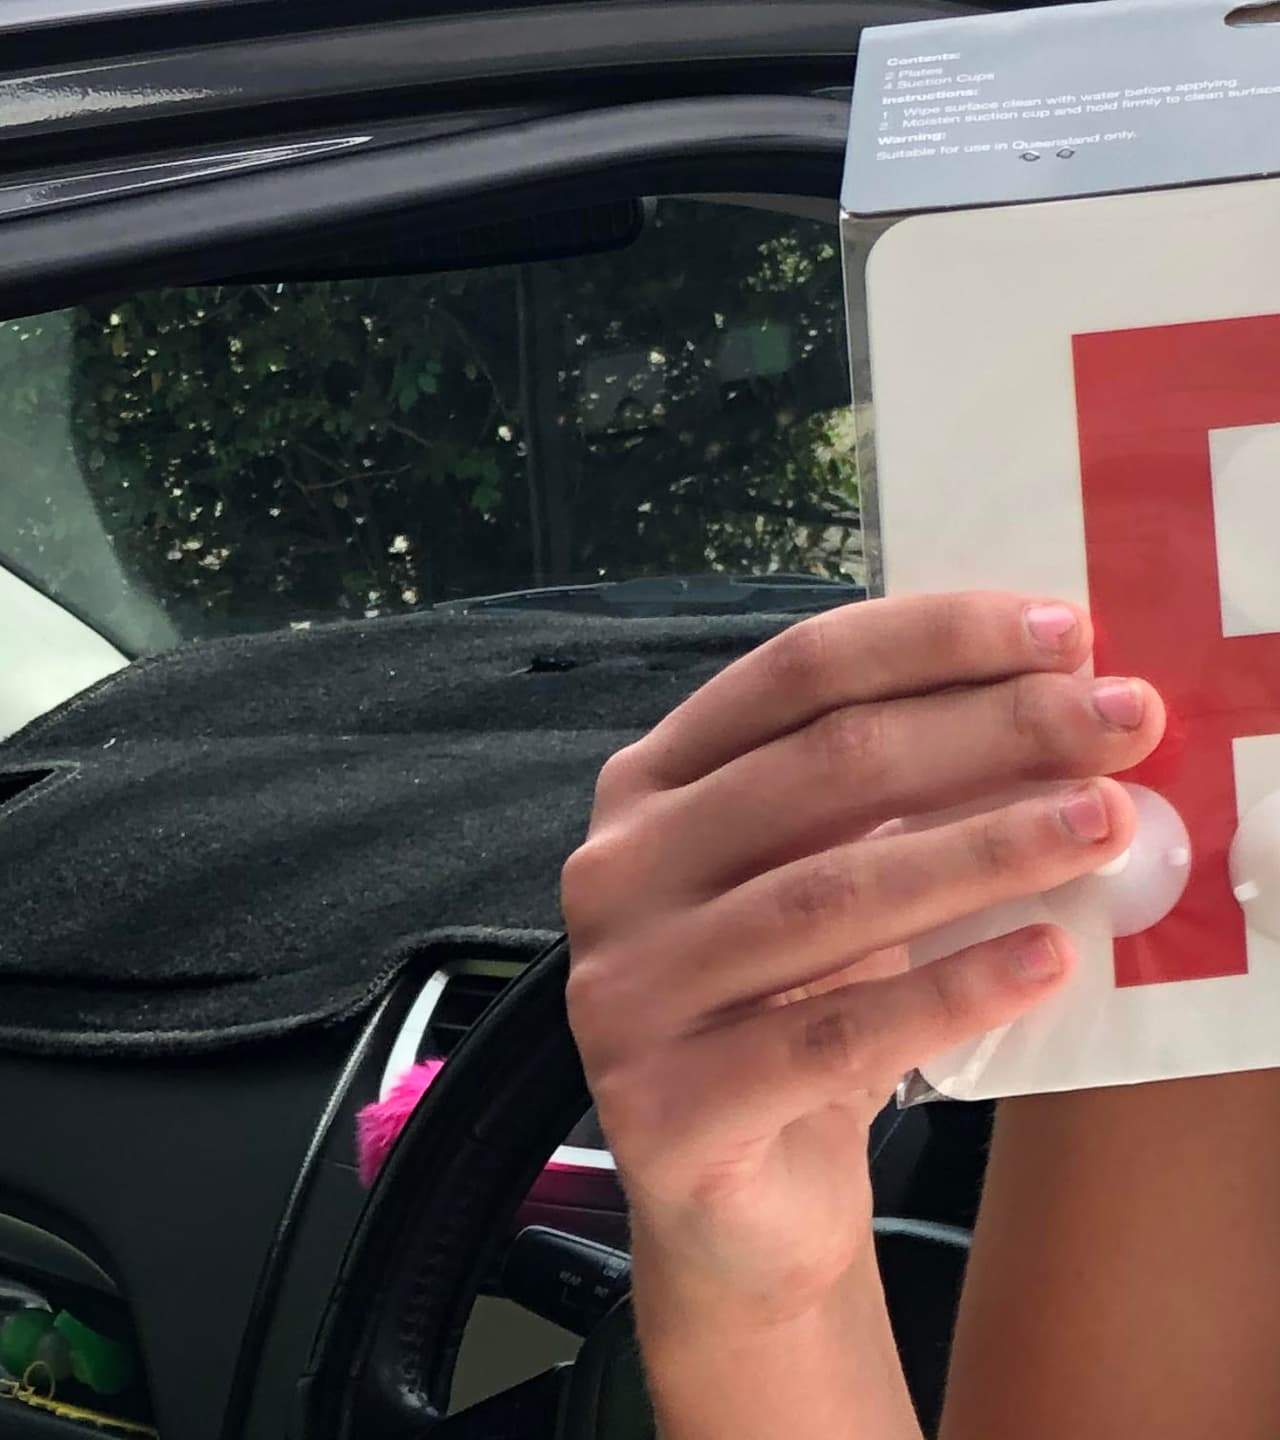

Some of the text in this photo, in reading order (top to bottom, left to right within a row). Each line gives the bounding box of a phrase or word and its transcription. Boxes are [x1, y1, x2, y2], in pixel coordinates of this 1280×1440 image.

[886, 52, 961, 67] Contents:
[897, 77, 952, 91] Suction
[956, 72, 995, 85] Cups
[898, 67, 943, 80] Plates
[882, 88, 979, 106] Instructions:
[903, 106, 941, 118] Wipe
[944, 100, 999, 113] surface
[1002, 97, 1042, 109] clean
[1046, 94, 1076, 106] with
[1081, 90, 1121, 103] water
[1125, 84, 1172, 97] before
[902, 114, 961, 129] Moisten
[964, 108, 1018, 122] suction
[1022, 109, 1050, 120] cup
[1054, 105, 1082, 116] and
[1086, 101, 1118, 113] hold
[1122, 97, 1162, 109] firmly
[1184, 91, 1224, 102] clean
[876, 146, 937, 161] Suitable
[940, 144, 960, 155] for
[964, 143, 991, 153] use
[1012, 133, 1100, 150] Queensland
[1104, 129, 1137, 143] only.
[877, 131, 947, 147] Warning:
